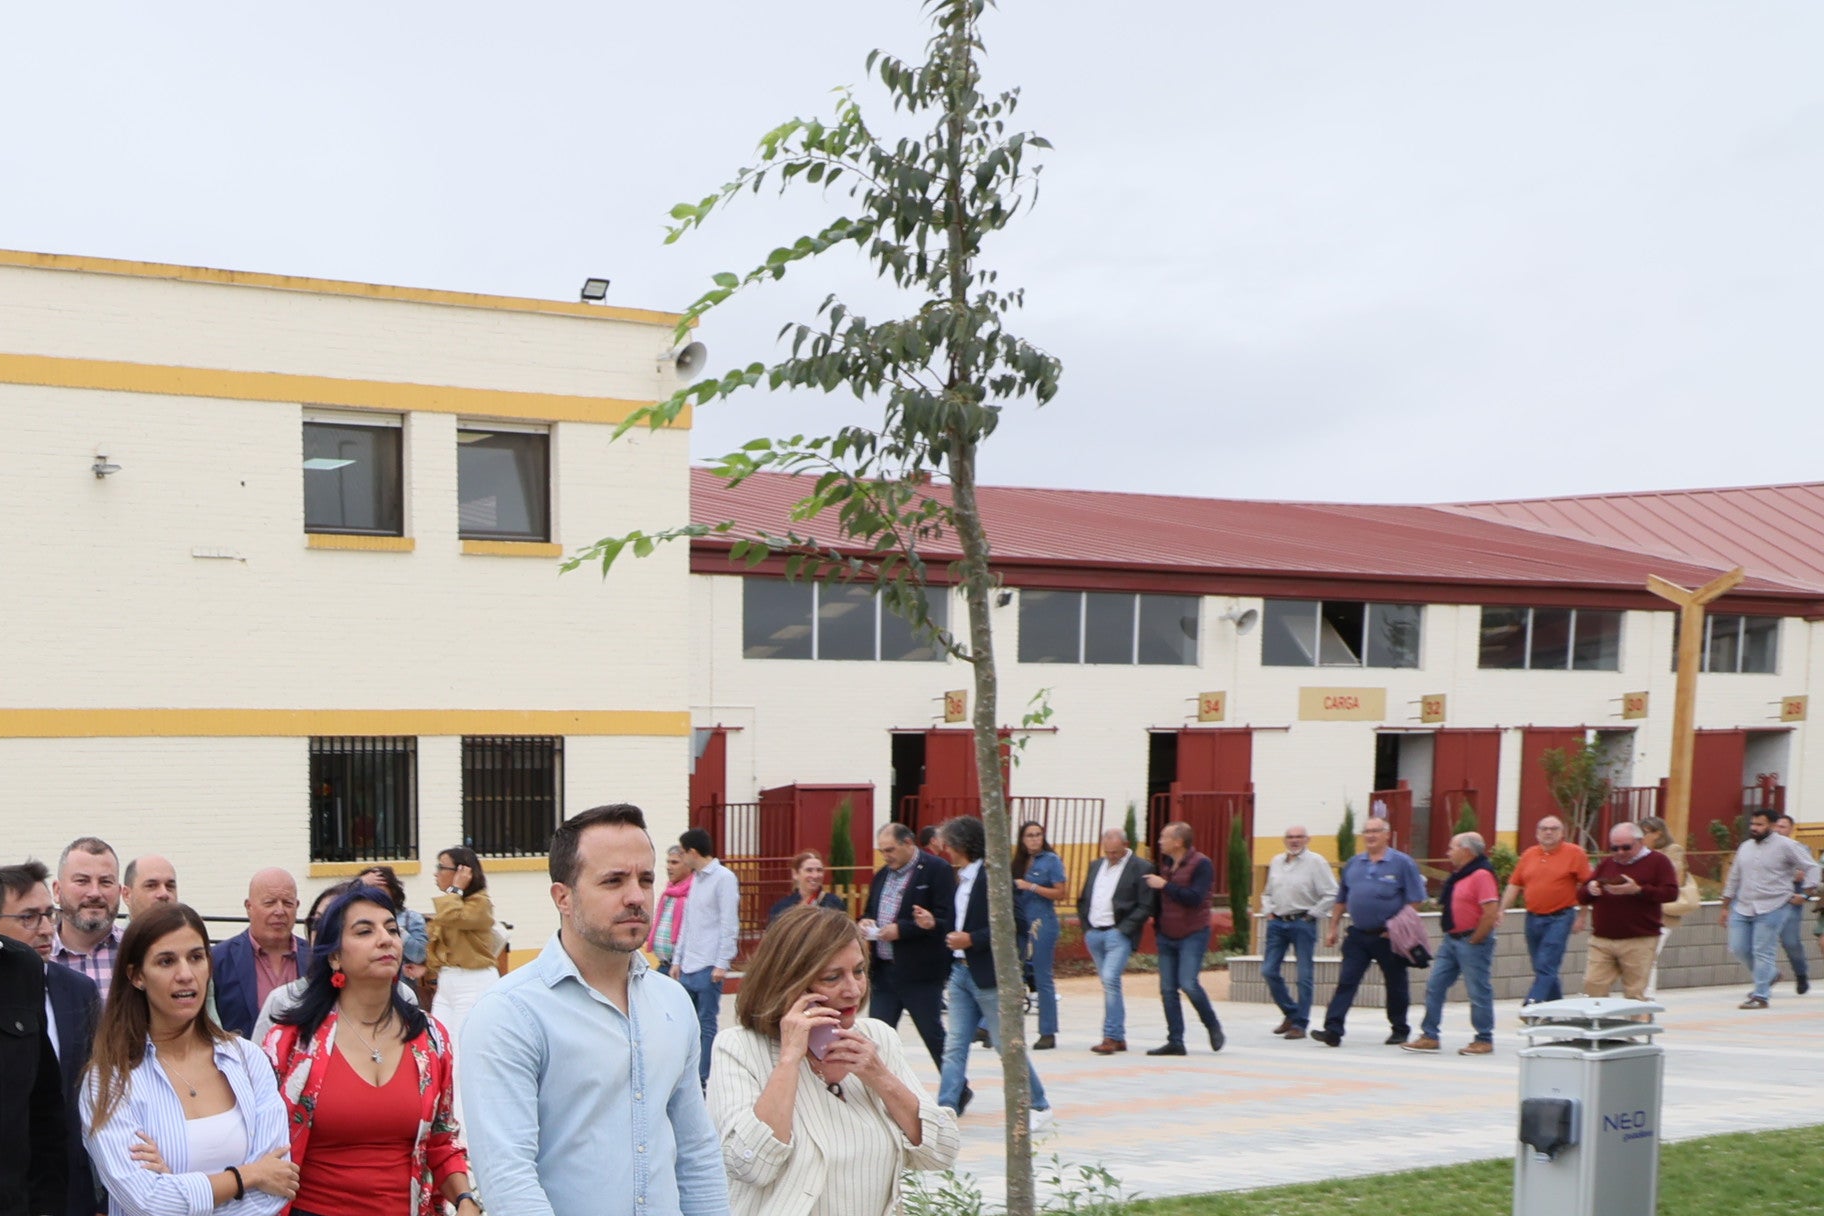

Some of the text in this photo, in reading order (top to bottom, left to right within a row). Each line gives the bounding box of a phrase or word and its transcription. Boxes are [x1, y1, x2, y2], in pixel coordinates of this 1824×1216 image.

[948, 698, 964, 715] 36
[1203, 699, 1221, 715] 34
[1323, 695, 1361, 711] CARGA
[1425, 700, 1442, 716] 32
[1602, 1110, 1647, 1132] NEO
